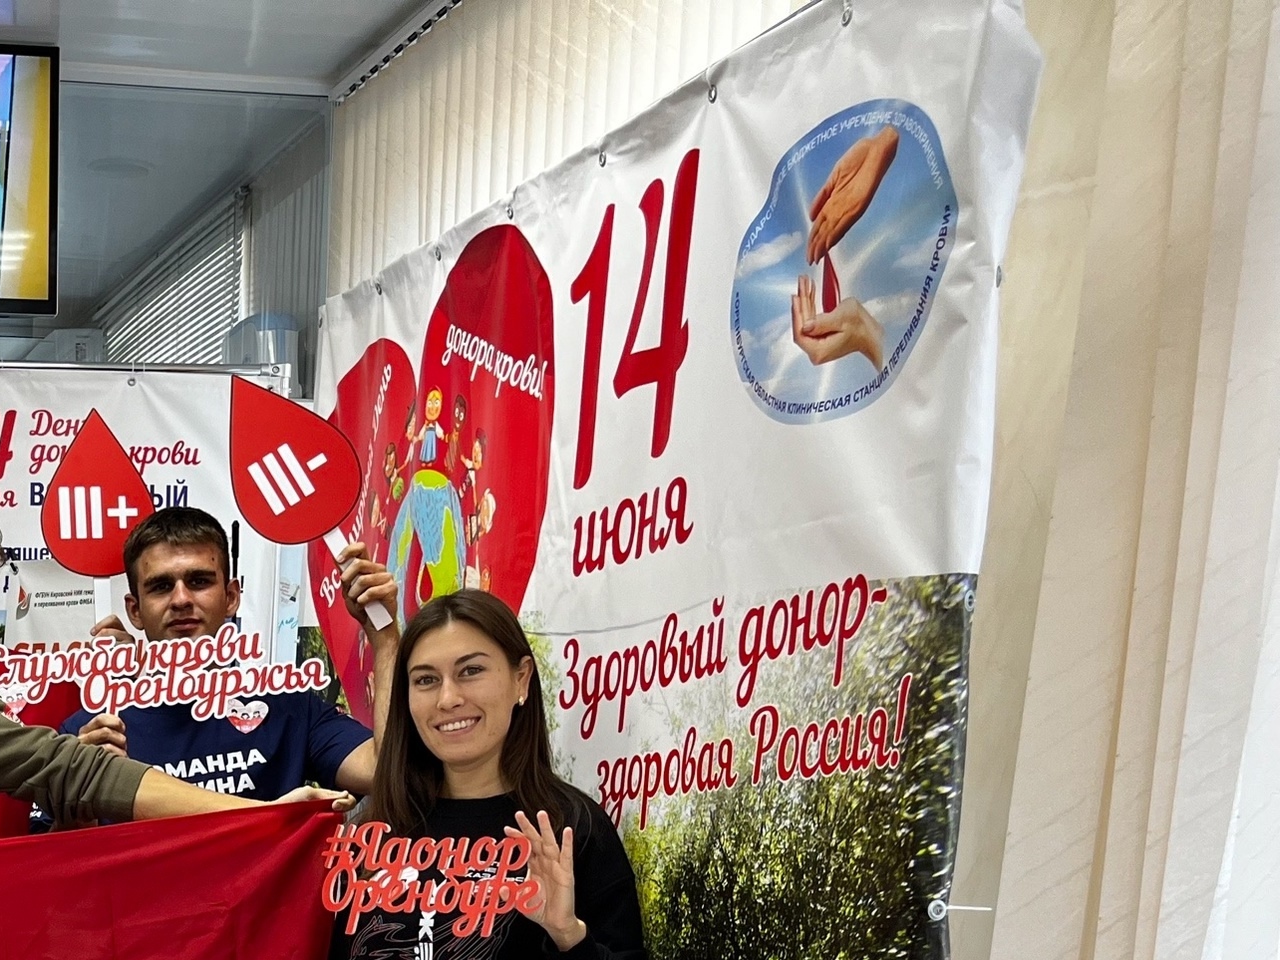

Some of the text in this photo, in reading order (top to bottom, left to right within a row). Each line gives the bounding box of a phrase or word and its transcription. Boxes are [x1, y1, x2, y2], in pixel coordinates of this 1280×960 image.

[570, 148, 700, 491] 14
[786, 394, 852, 416] КЛИНИЧЕСКАЯ
[852, 368, 891, 404] СТАНЦИЯ
[888, 274, 935, 373] ПЕРЕЛИВАНИЯ
[929, 204, 952, 274] КРОВИ»
[441, 323, 549, 401] донора крови!
[28, 409, 87, 437] Ден
[127, 440, 202, 475] крови
[57, 485, 139, 540] III+
[571, 476, 695, 577] июня
[82, 658, 327, 719] Оренбуржья
[558, 573, 888, 740] Здоровый донор-
[152, 748, 268, 778] МАНДА
[596, 673, 913, 831] здоровая Россия!
[322, 821, 532, 880] #Ядонор
[321, 861, 546, 938] Оренбург
